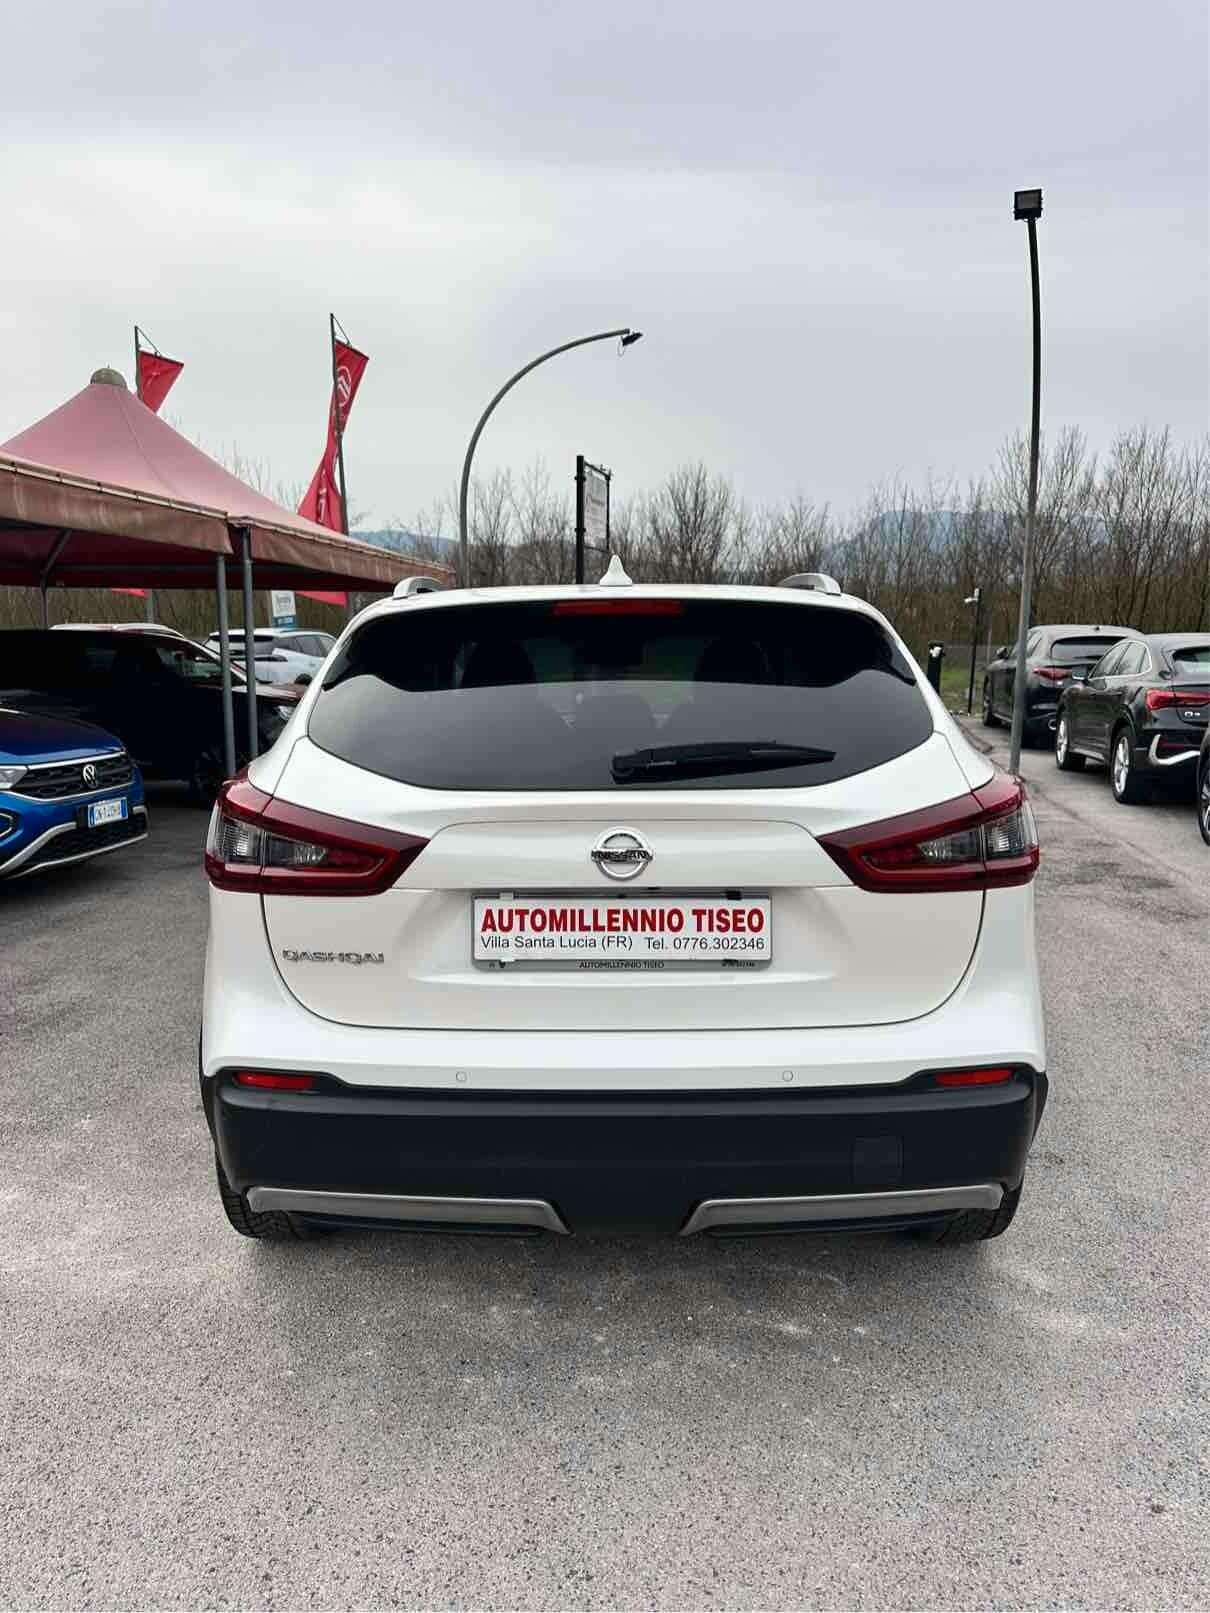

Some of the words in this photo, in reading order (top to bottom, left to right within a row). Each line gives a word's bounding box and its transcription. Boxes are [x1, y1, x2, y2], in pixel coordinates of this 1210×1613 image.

[481, 908, 684, 933] AUTOMILLENNIO
[691, 908, 765, 933] TISEO
[480, 935, 510, 949] Villa
[514, 935, 555, 949] Santa
[559, 935, 596, 949] Lucia
[601, 935, 633, 951] (FR)
[645, 937, 668, 950] Tel.
[673, 937, 765, 950] 0776.302346
[282, 950, 385, 964] QASHQAI
